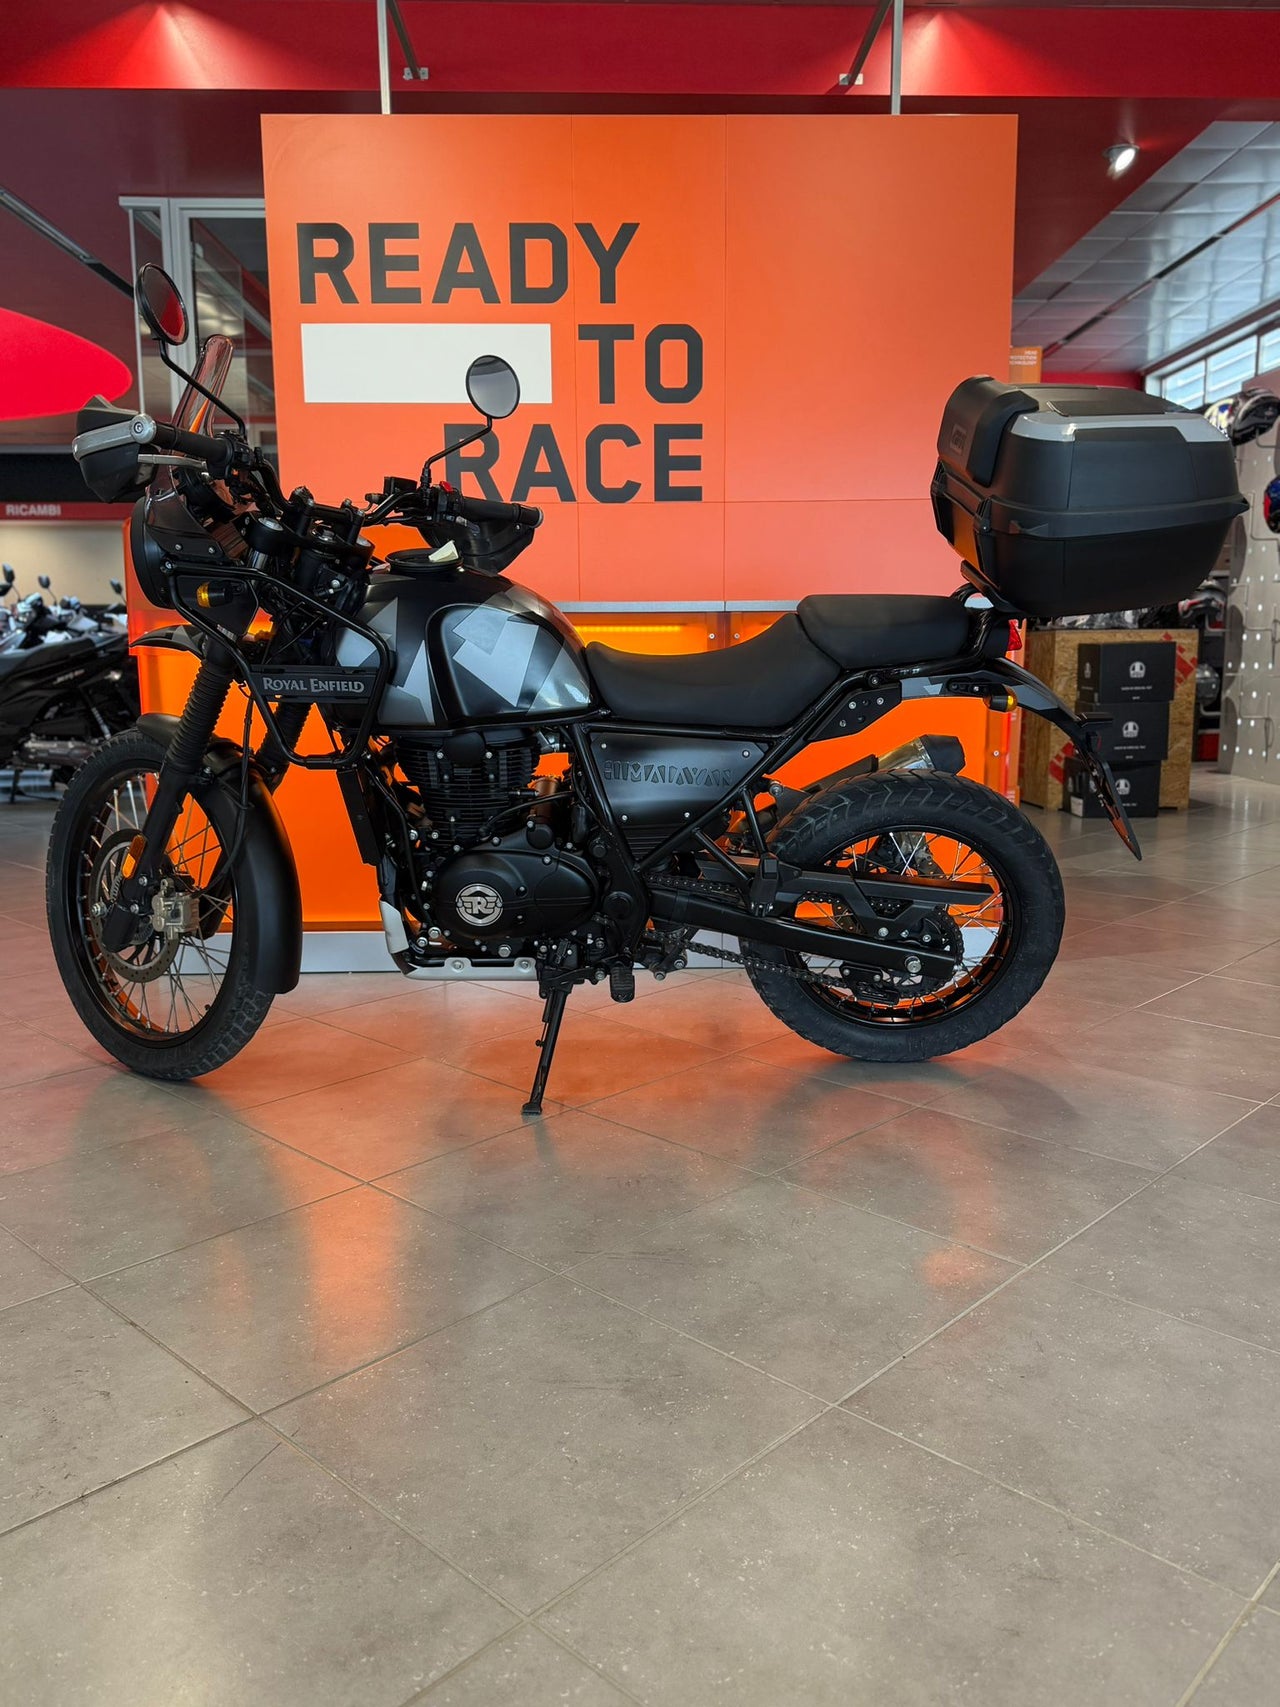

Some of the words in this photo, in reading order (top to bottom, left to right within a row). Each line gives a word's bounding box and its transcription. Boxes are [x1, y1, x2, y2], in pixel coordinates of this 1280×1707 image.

[296, 222, 640, 304] READY
[578, 323, 703, 404] TO
[443, 423, 703, 504] RACE
[6, 503, 62, 517] RICAMBI
[263, 677, 308, 691] ROYAL
[310, 678, 365, 693] ENFIELD
